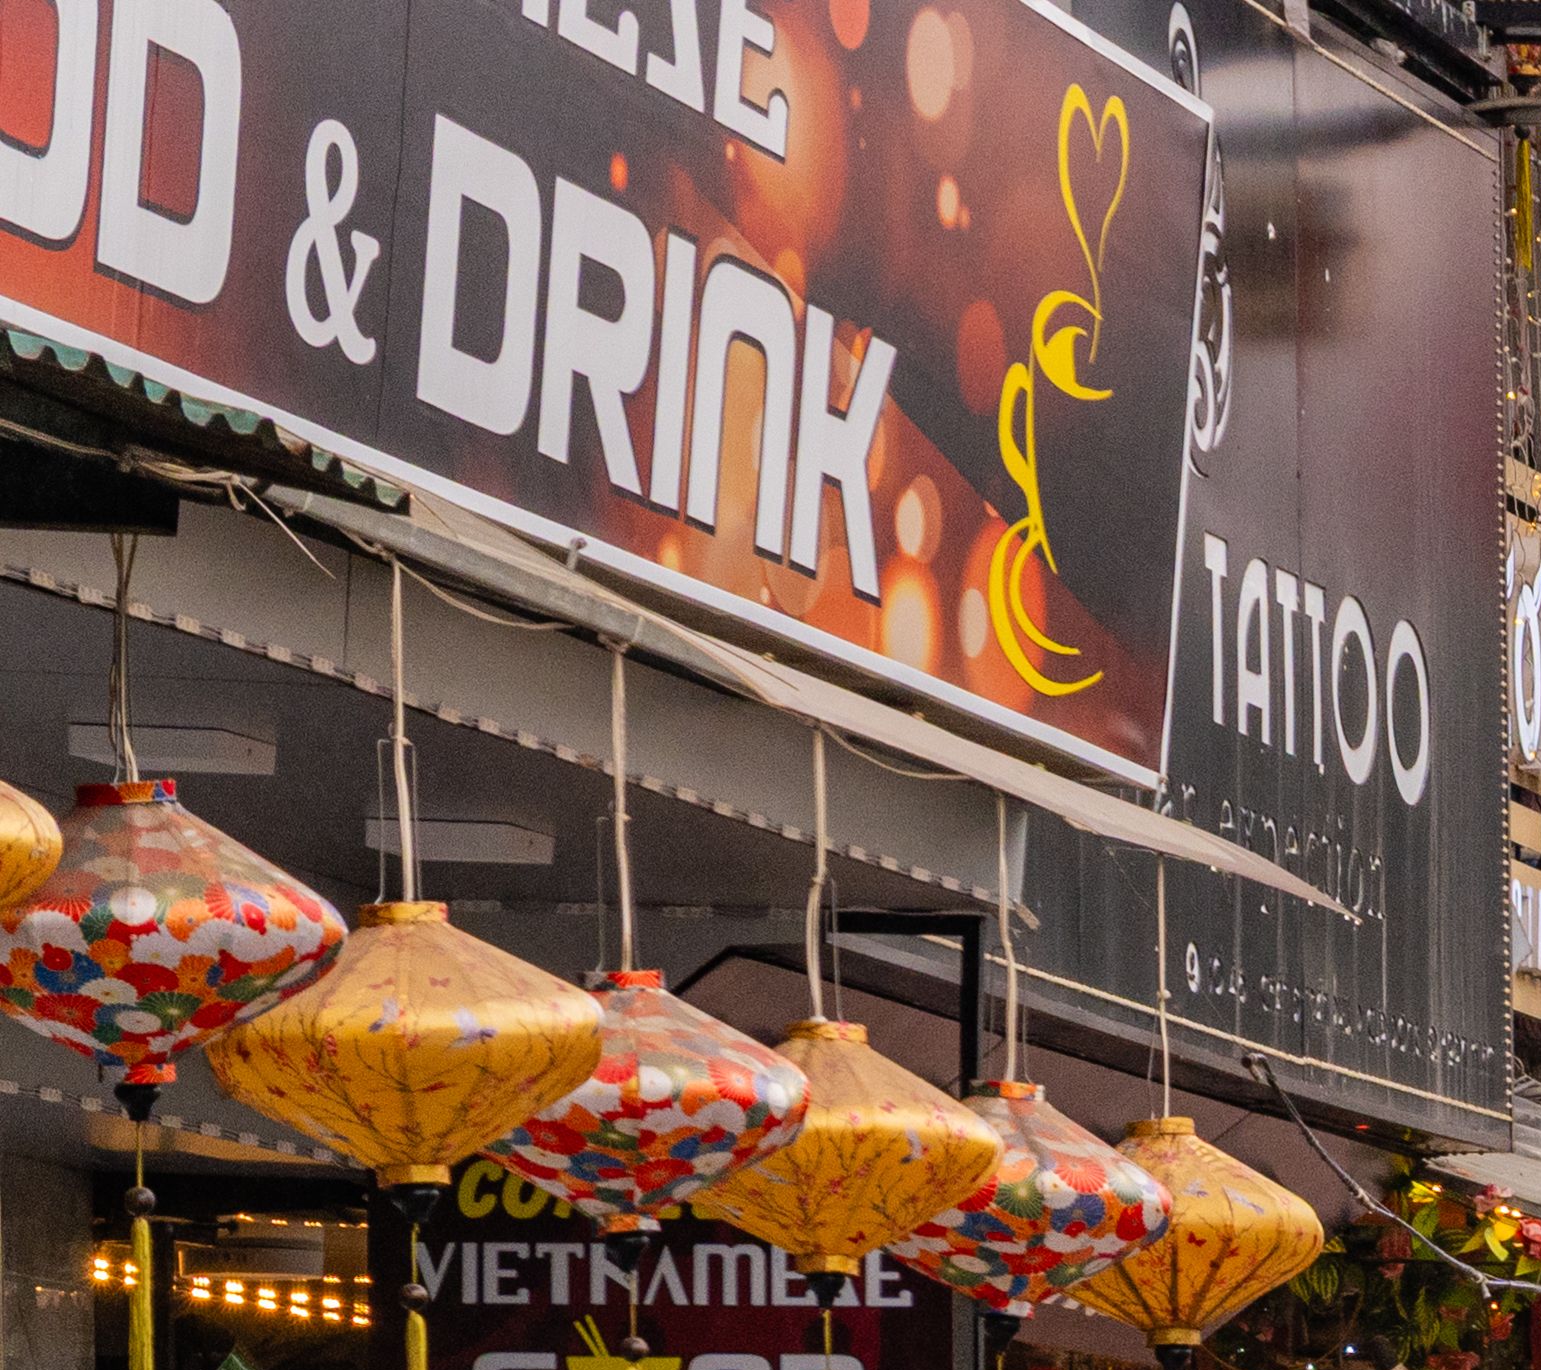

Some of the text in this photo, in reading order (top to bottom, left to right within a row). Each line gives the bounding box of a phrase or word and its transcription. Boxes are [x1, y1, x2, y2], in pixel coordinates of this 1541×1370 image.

[286, 119, 380, 364] &
[416, 112, 898, 604] DRINK
[1204, 531, 1432, 806] TATTOO
